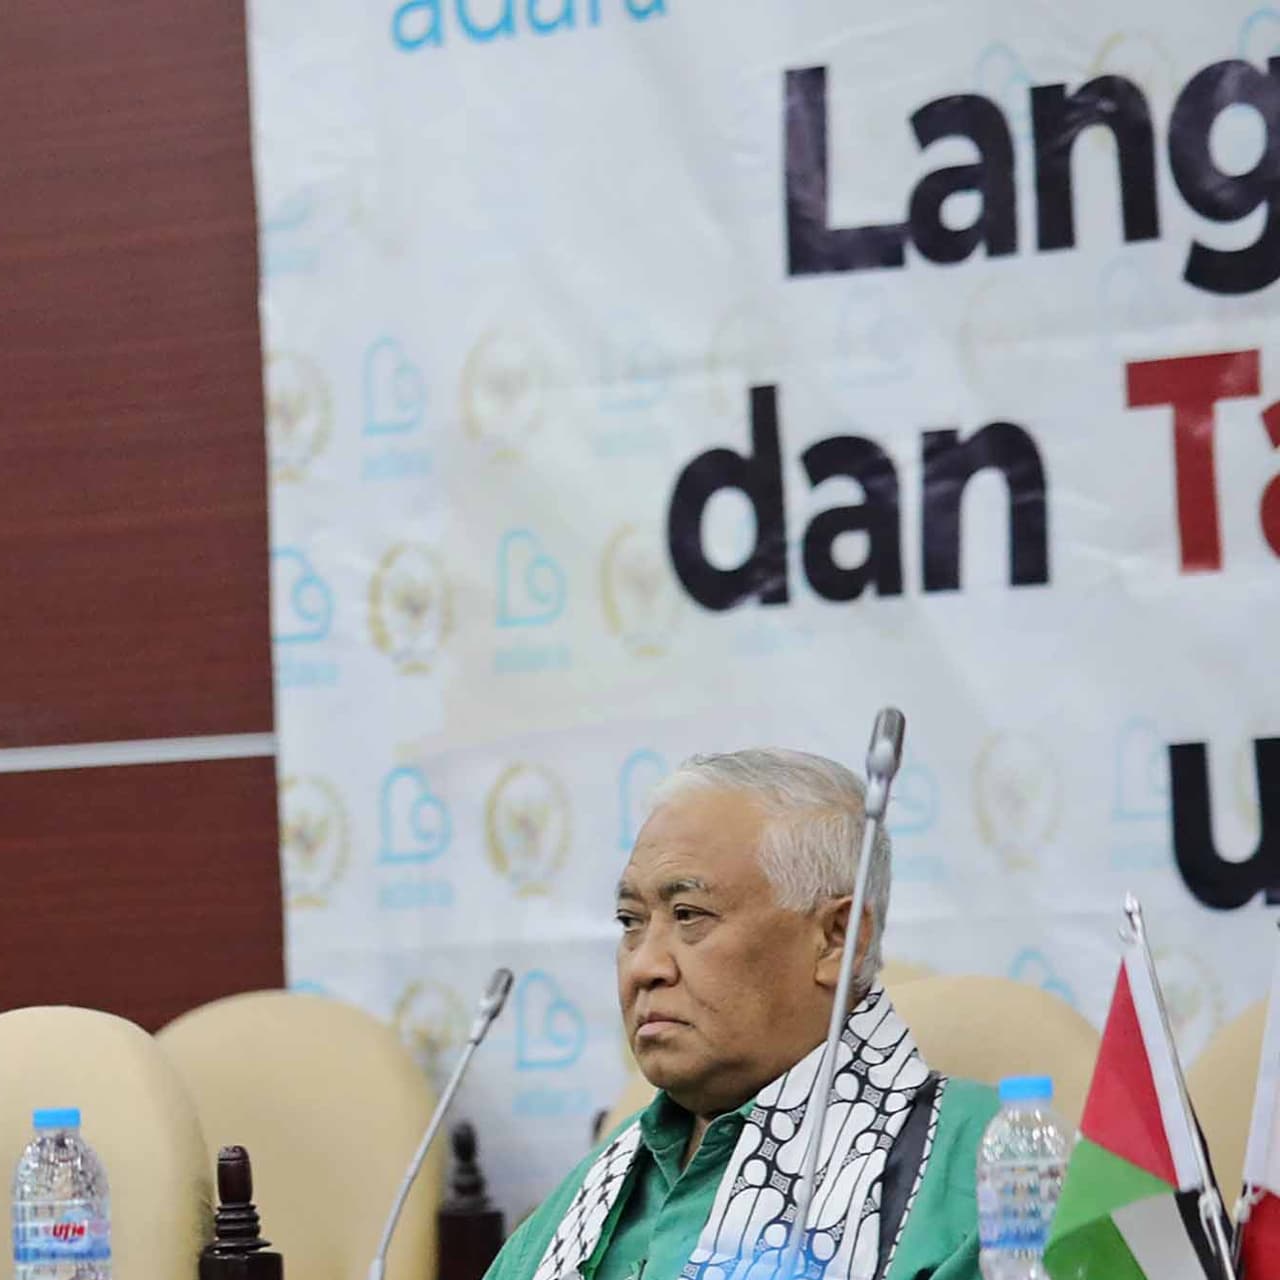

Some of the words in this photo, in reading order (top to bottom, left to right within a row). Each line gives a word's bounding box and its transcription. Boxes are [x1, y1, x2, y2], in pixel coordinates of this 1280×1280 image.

[782, 56, 1280, 294] Lang
[667, 384, 1049, 613] dan
[1126, 350, 1280, 572] T
